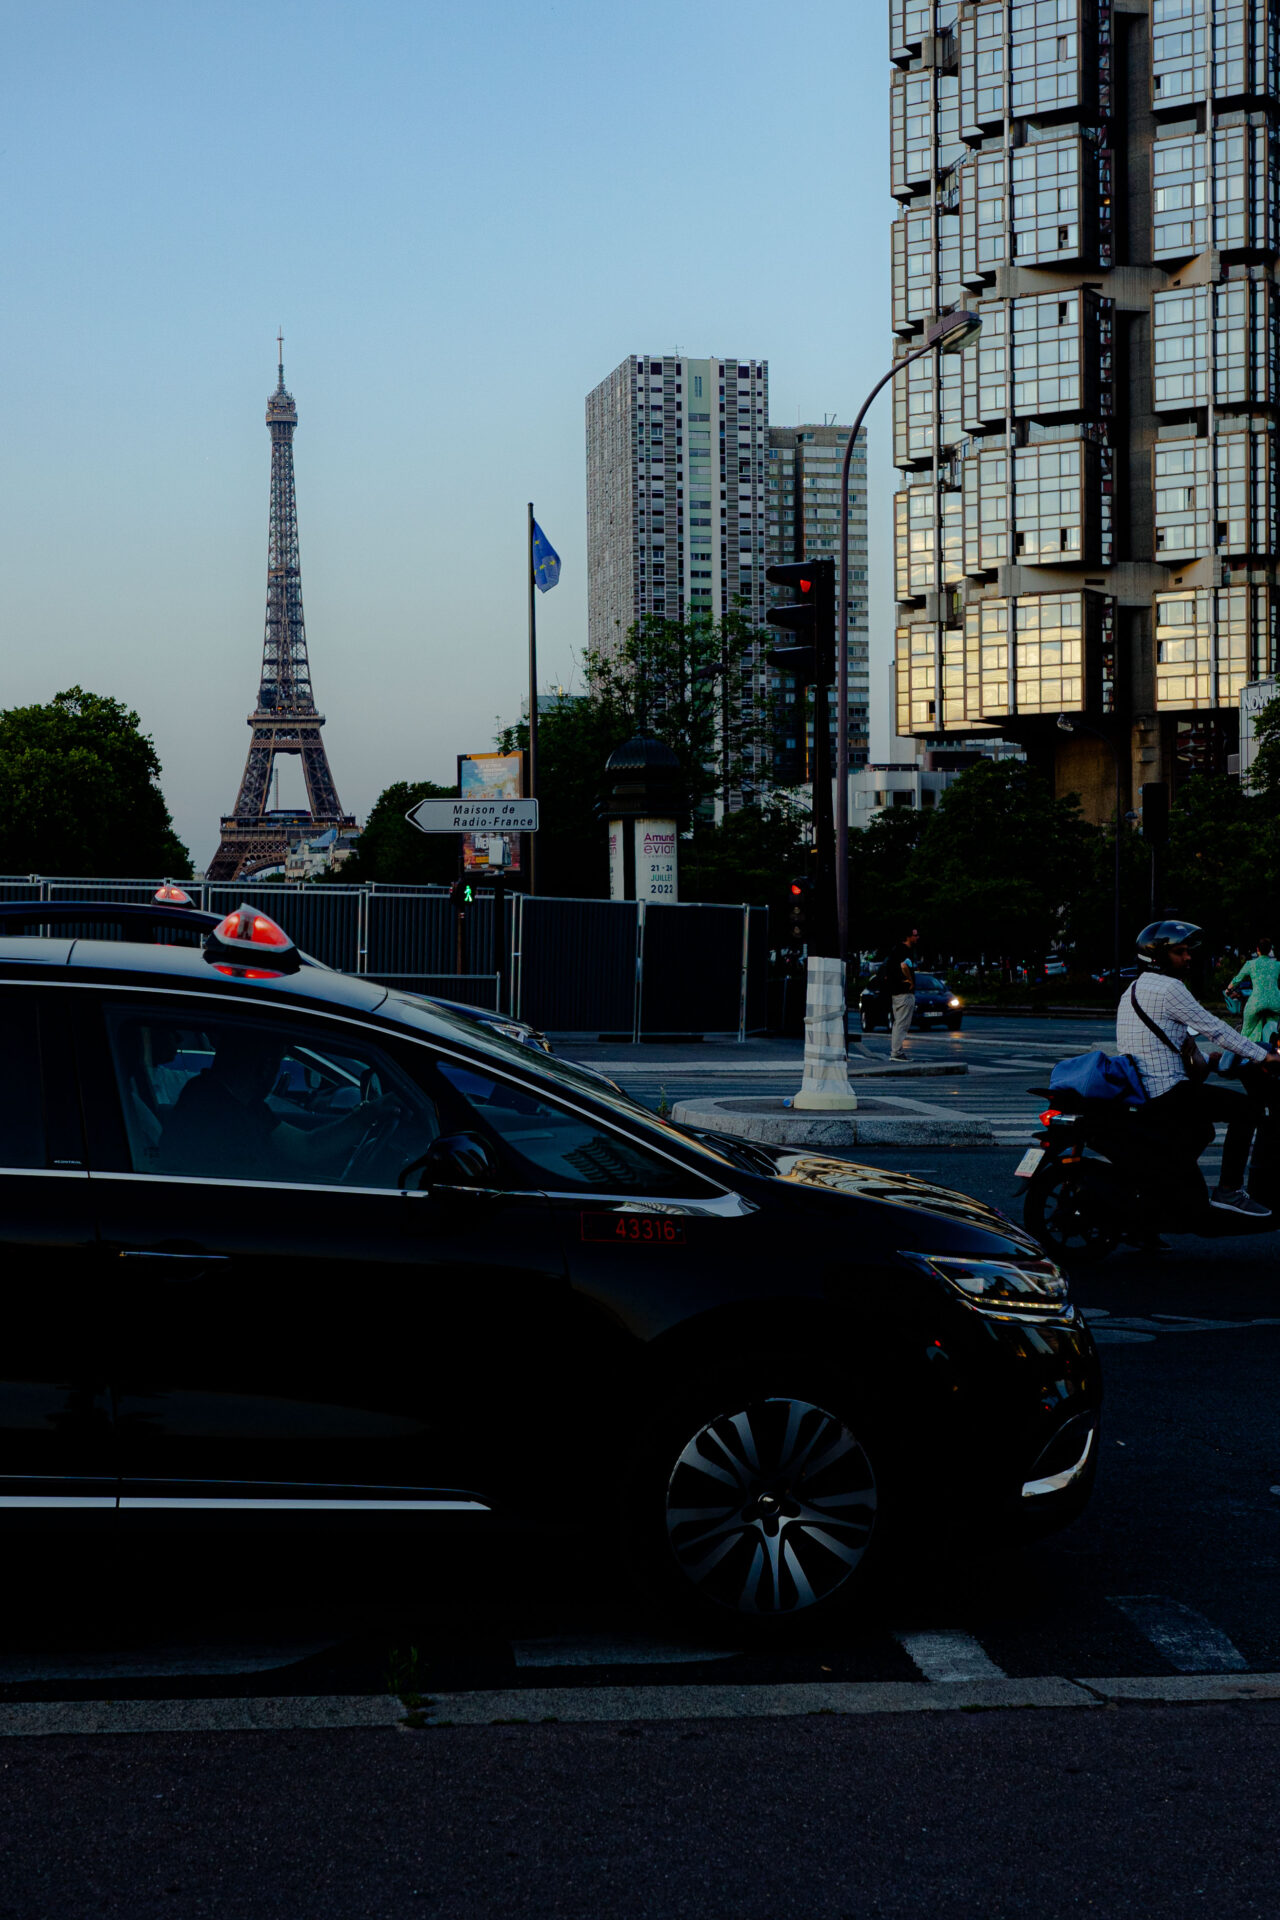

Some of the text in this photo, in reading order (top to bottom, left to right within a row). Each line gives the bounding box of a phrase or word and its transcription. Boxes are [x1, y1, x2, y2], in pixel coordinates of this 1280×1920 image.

[453, 804, 515, 815] Maison de
[453, 816, 533, 827] Radio-France
[650, 864, 660, 872] 21
[650, 884, 673, 894] 2022
[615, 1217, 676, 1241] 43316
